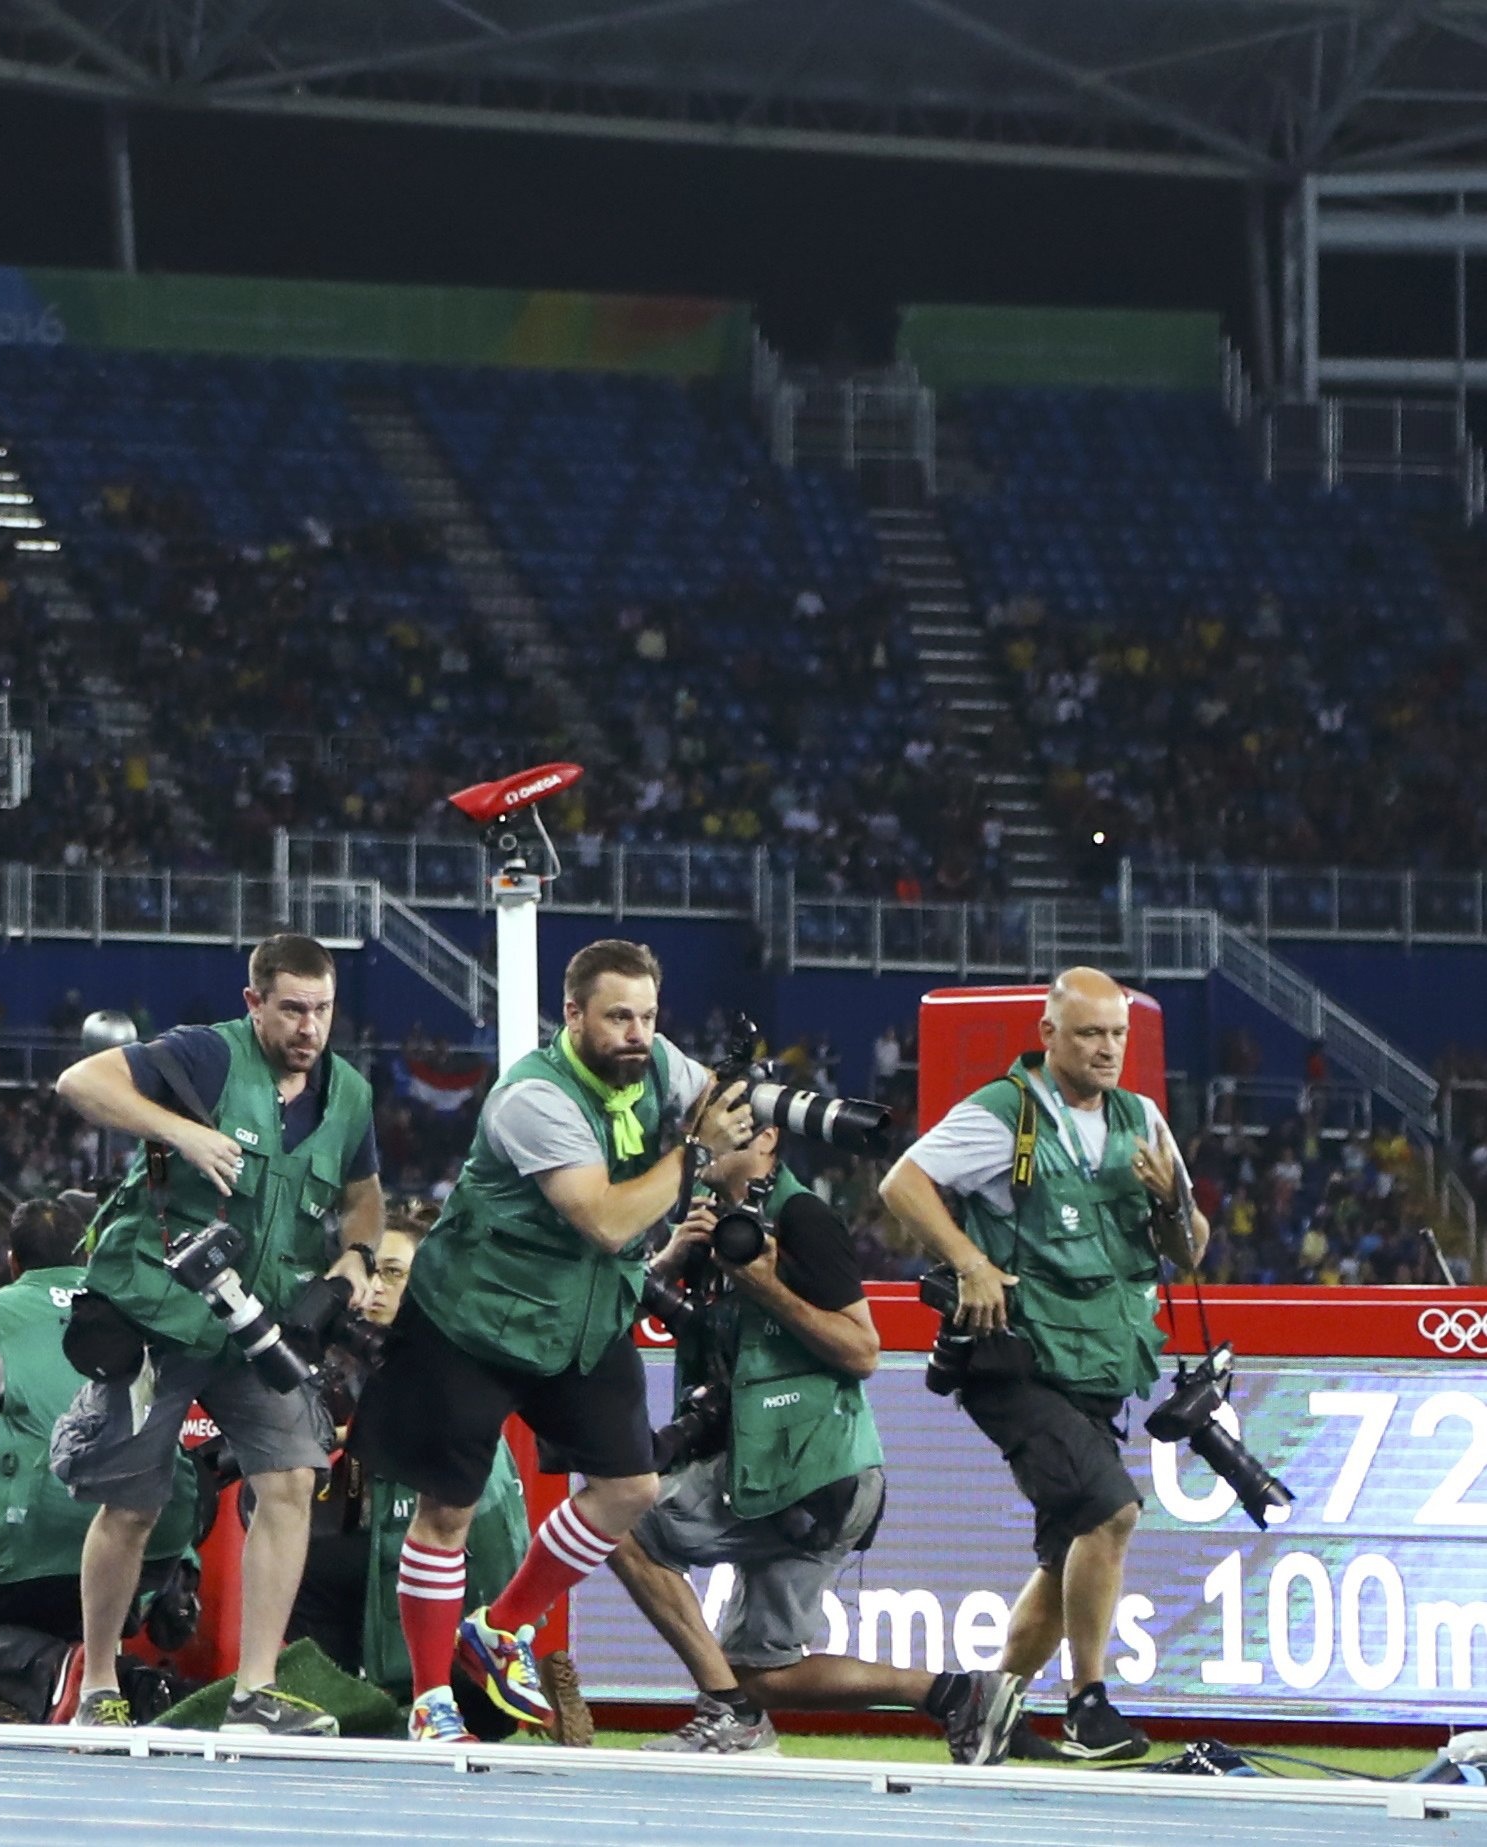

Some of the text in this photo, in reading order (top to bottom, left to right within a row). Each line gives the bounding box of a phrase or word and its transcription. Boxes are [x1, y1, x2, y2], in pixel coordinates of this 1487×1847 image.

[762, 1391, 801, 1409] PHOTO
[178, 1418, 221, 1442] MEG
[1200, 1549, 1487, 1691] 100m
